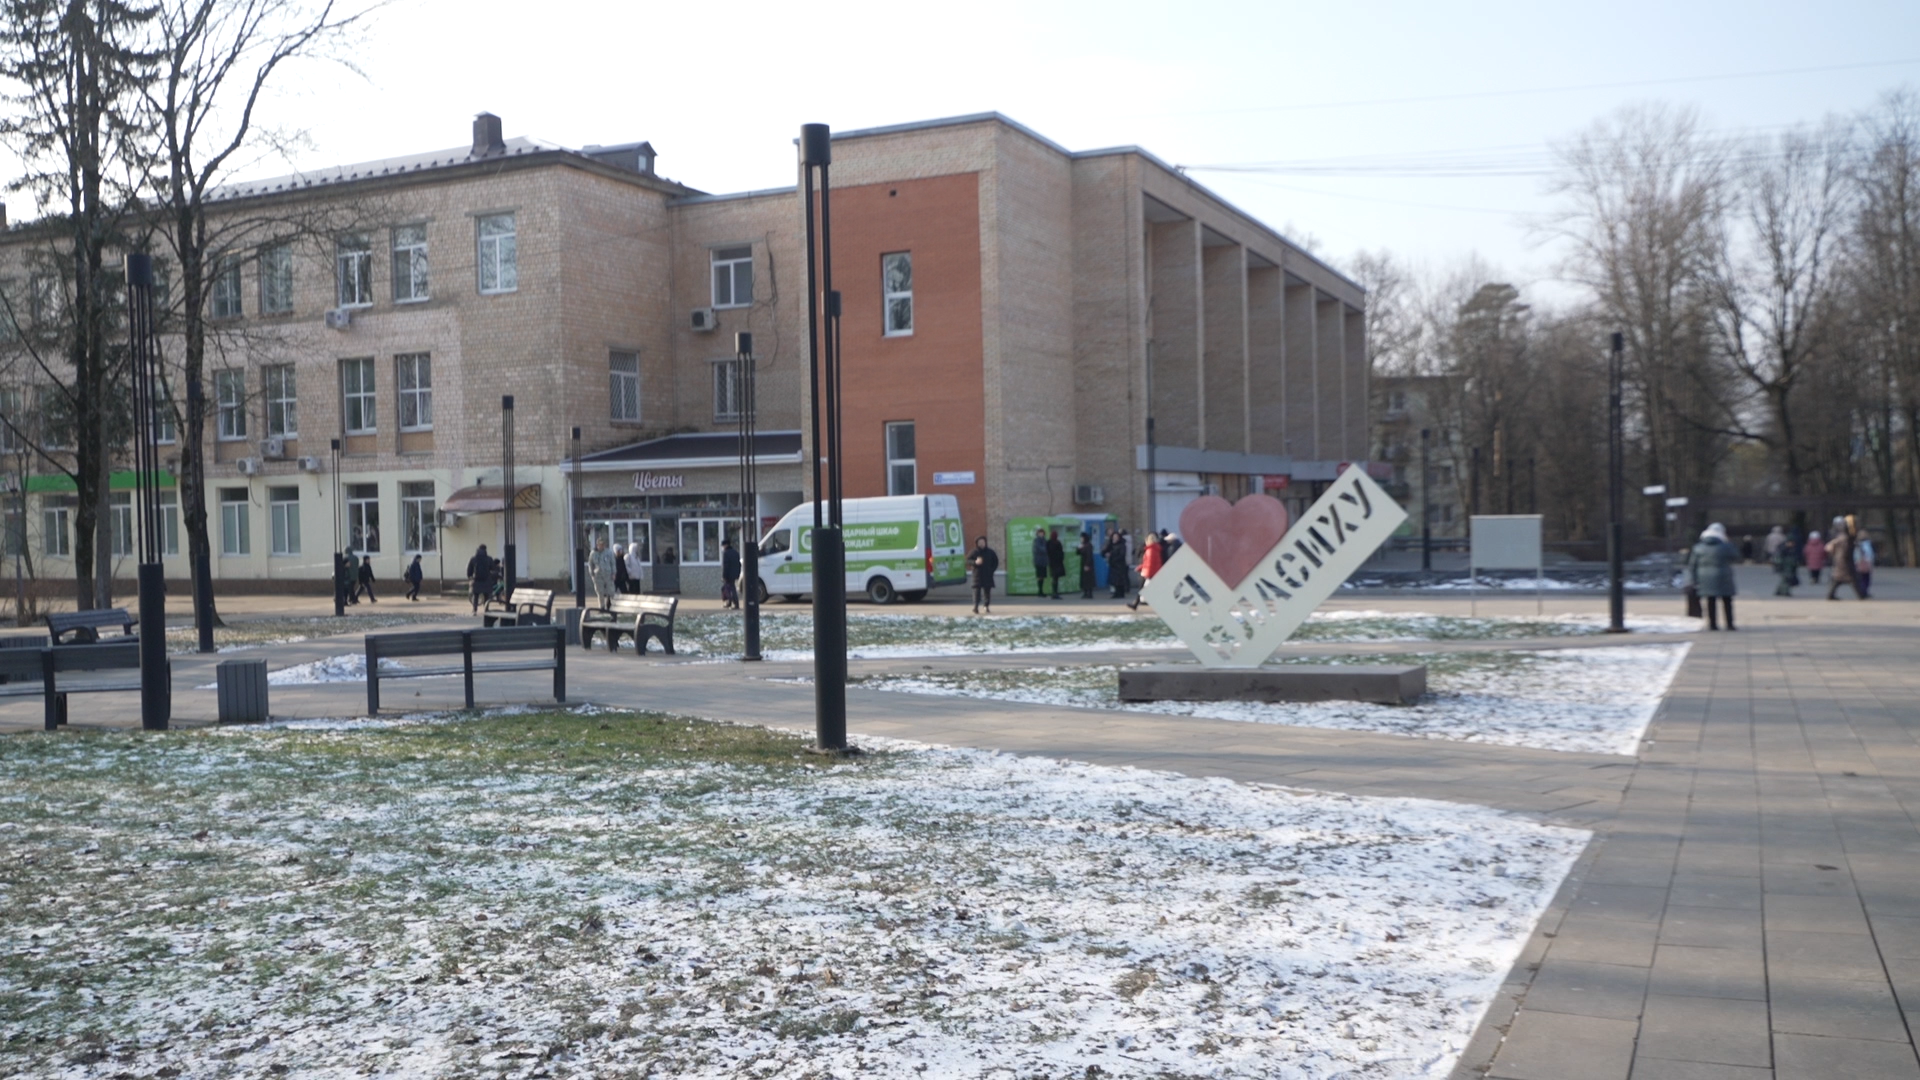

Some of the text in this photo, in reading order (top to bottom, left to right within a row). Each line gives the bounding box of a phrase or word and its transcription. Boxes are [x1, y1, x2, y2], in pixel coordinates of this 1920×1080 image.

[632, 470, 684, 491] Цветы
[876, 526, 899, 536] ШКАФ
[1204, 479, 1372, 661] ВЛАСИХУ
[1173, 574, 1212, 620] Я
